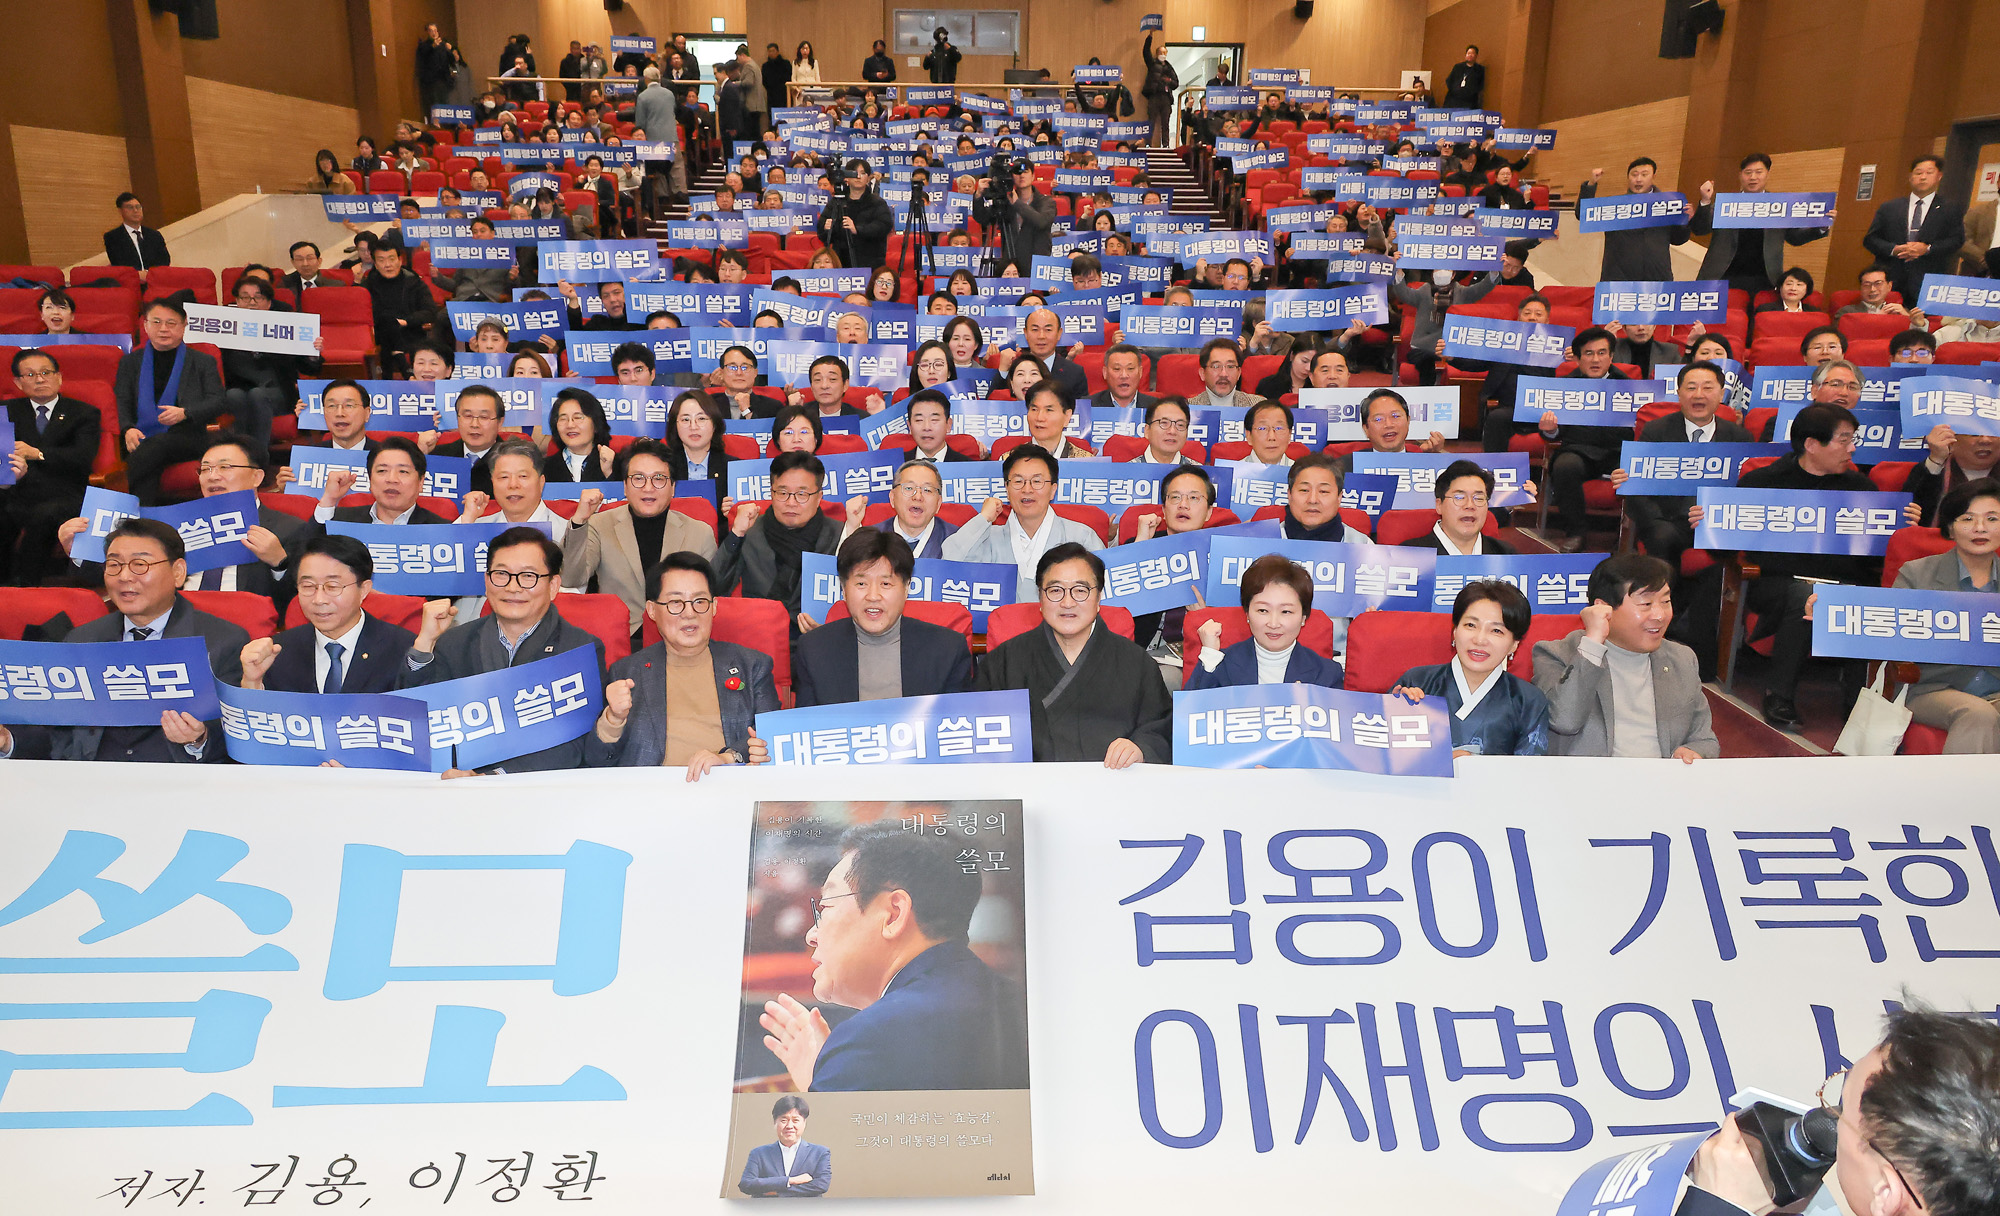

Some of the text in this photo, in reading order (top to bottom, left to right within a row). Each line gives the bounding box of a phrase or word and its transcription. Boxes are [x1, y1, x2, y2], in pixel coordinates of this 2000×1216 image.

[888, 124, 920, 136] 대통령의
[1430, 125, 1464, 136] 대통령의
[794, 137, 848, 151] 대통령의 쓸모
[1236, 152, 1285, 168] 대통령의 쓸모
[544, 178, 558, 192] 쓸모
[932, 172, 948, 183] 쓸모
[1056, 174, 1090, 185] 대통령의
[1368, 185, 1437, 199] 대통령의 쓸모
[326, 202, 396, 214] 대통령의 쓸모
[1585, 200, 1683, 222] 대통령의 쓸모
[1721, 201, 1825, 218] 대통령의 쓸모
[748, 214, 813, 228] 대통령의 쓸모
[942, 212, 963, 224] 쓸모
[1270, 211, 1310, 226] 대통령의
[1479, 215, 1553, 229] 대통령의 쓸모
[407, 226, 452, 238] 대통령의
[538, 226, 560, 237] 쓸모
[672, 228, 742, 240] 대통령의 쓸모
[1136, 222, 1179, 234] 대통령의
[1399, 223, 1476, 236] 대통령의 쓸모
[435, 247, 510, 259] 대통령의 쓸모
[1078, 238, 1097, 252] 쓸모
[1185, 238, 1269, 258] 대통령의 쓸모
[1295, 238, 1364, 251] 대통령의 쓸모
[1403, 243, 1497, 260] 대통령의 쓸모
[545, 250, 650, 270] 대통령의 쓸모
[1369, 258, 1394, 274] 쓸모
[838, 277, 864, 291] 쓸모
[632, 294, 740, 312] 대통령의 쓸모
[1107, 292, 1135, 311] 쓸모
[1272, 295, 1379, 318] 대통령의 쓸모
[1600, 292, 1719, 312] 대통령의 쓸모
[524, 310, 560, 329] 쓸모
[1064, 316, 1096, 333] 쓸모
[1127, 316, 1233, 334] 대통령의 쓸모
[188, 317, 314, 342] 김용의 꿈 너머 꿈
[877, 322, 908, 338] 쓸모
[980, 326, 1008, 343] 쓸모
[1448, 323, 1565, 355] 대통령의 쓸모
[655, 340, 691, 360] 쓸모
[860, 356, 898, 376] 쓸모
[1524, 389, 1654, 411] 대통령의 쓸모
[1433, 402, 1452, 421] 꿈
[1630, 457, 1732, 479] 대통령의
[844, 465, 895, 494] 쓸모
[1058, 478, 1160, 504] 대통령의
[1709, 504, 1896, 534] 대통령의 쓸모
[178, 511, 247, 551] 쓸모
[1101, 551, 1200, 599] 통령의
[1356, 564, 1418, 597] 쓸모
[942, 580, 1000, 611] 쓸모
[1537, 574, 1588, 604] 쓸모
[1827, 605, 1970, 642] 대통령의
[102, 662, 194, 701] 쓸모
[429, 671, 589, 750] 령의 쓸모
[220, 702, 414, 755] 통령의 쓸모
[1188, 704, 1431, 749] 대통령의 쓸모
[773, 715, 1013, 765] 대통령의 쓸모
[804, 829, 822, 837] 시간
[901, 813, 1006, 836] 대통령의
[955, 850, 1010, 874] 쓸모
[1117, 824, 2000, 967] 김용이 기록한
[0, 830, 633, 1129] 쓸모
[1133, 1000, 1739, 1152] 이재명의
[850, 1112, 888, 1125] 국민이
[894, 1111, 945, 1124] 체감하는
[856, 1134, 994, 1147] 그것이 대통령의 쓸모다
[97, 1150, 607, 1209] 저자. 김용, 이정환
